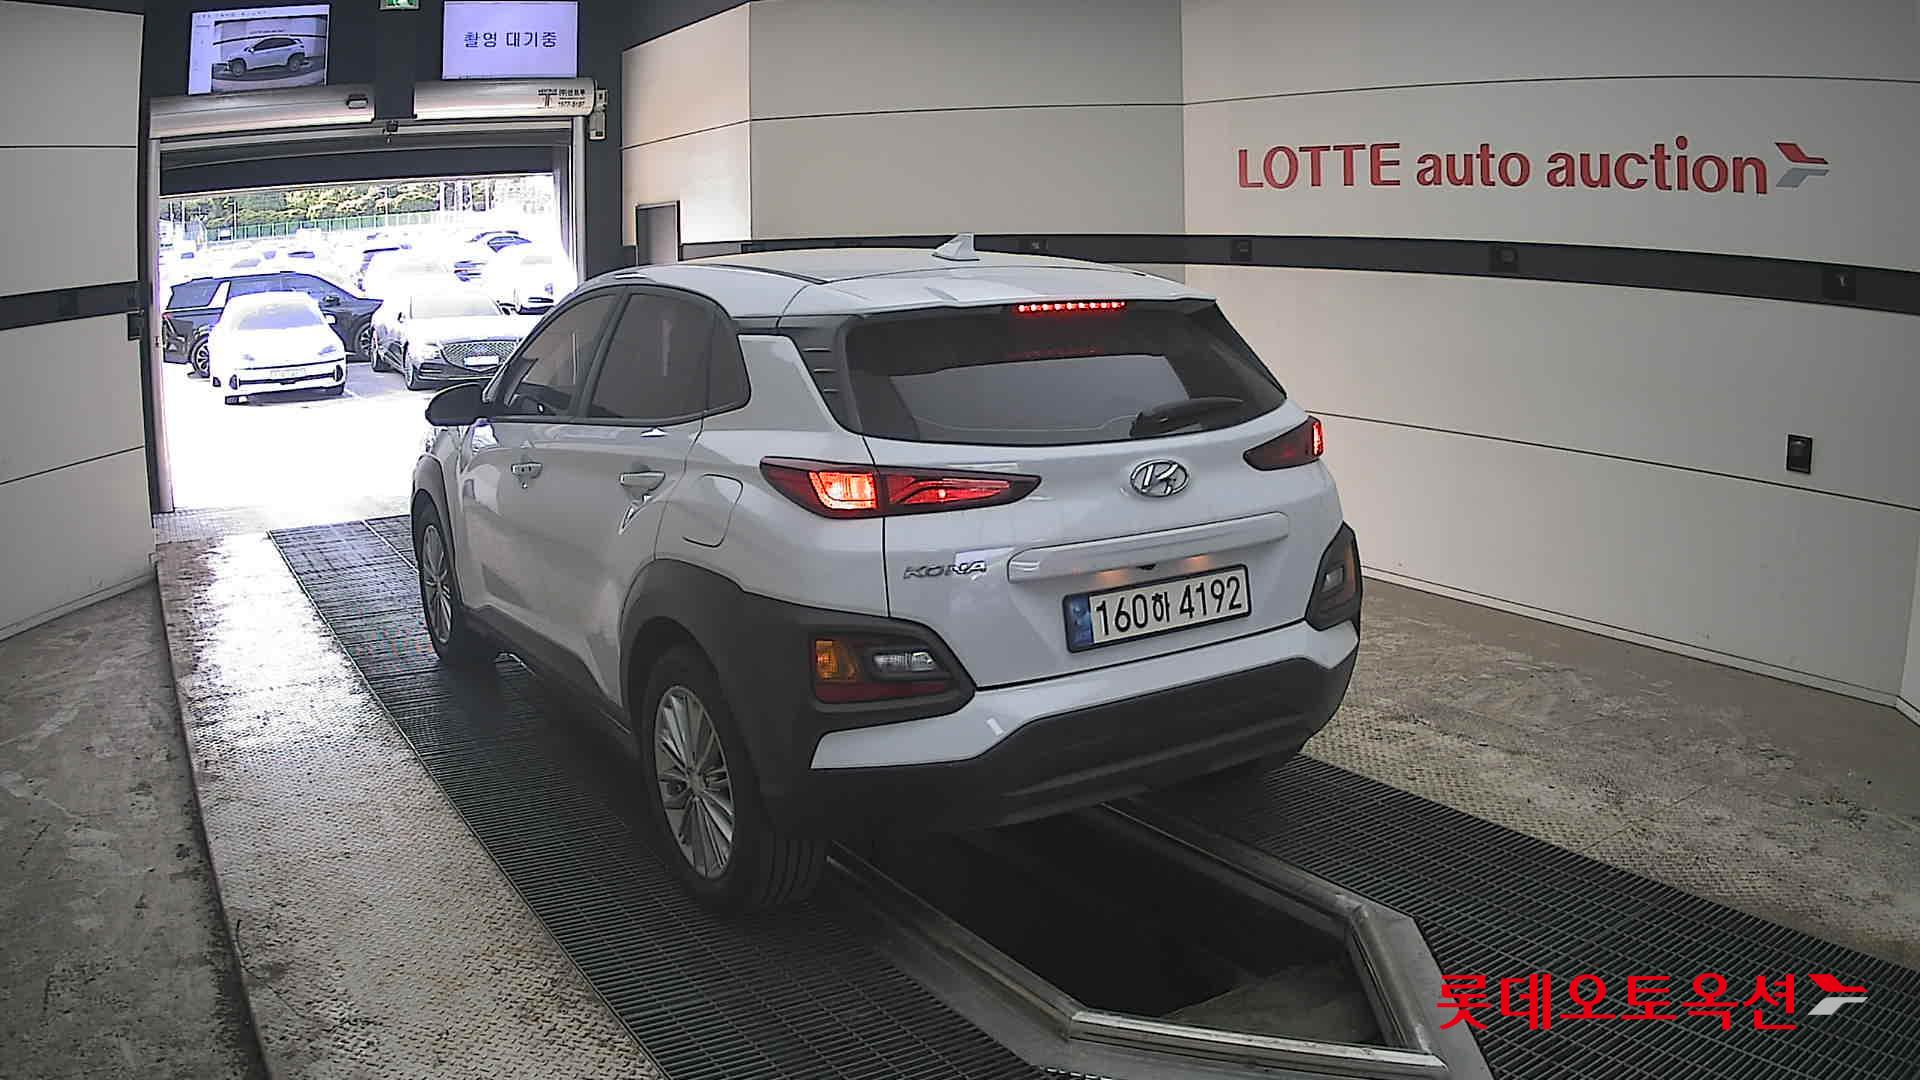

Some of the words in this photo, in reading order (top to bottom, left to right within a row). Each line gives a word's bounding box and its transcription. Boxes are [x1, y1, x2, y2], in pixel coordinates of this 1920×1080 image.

[464, 32, 496, 47] 촬영
[506, 32, 557, 47] 대기중
[1238, 143, 1400, 189] LOTTE
[1416, 143, 1531, 187] auto
[1546, 135, 1767, 194] auction
[903, 560, 987, 579] KONA
[1096, 591, 1171, 636] 160하
[1179, 576, 1242, 619] 4192
